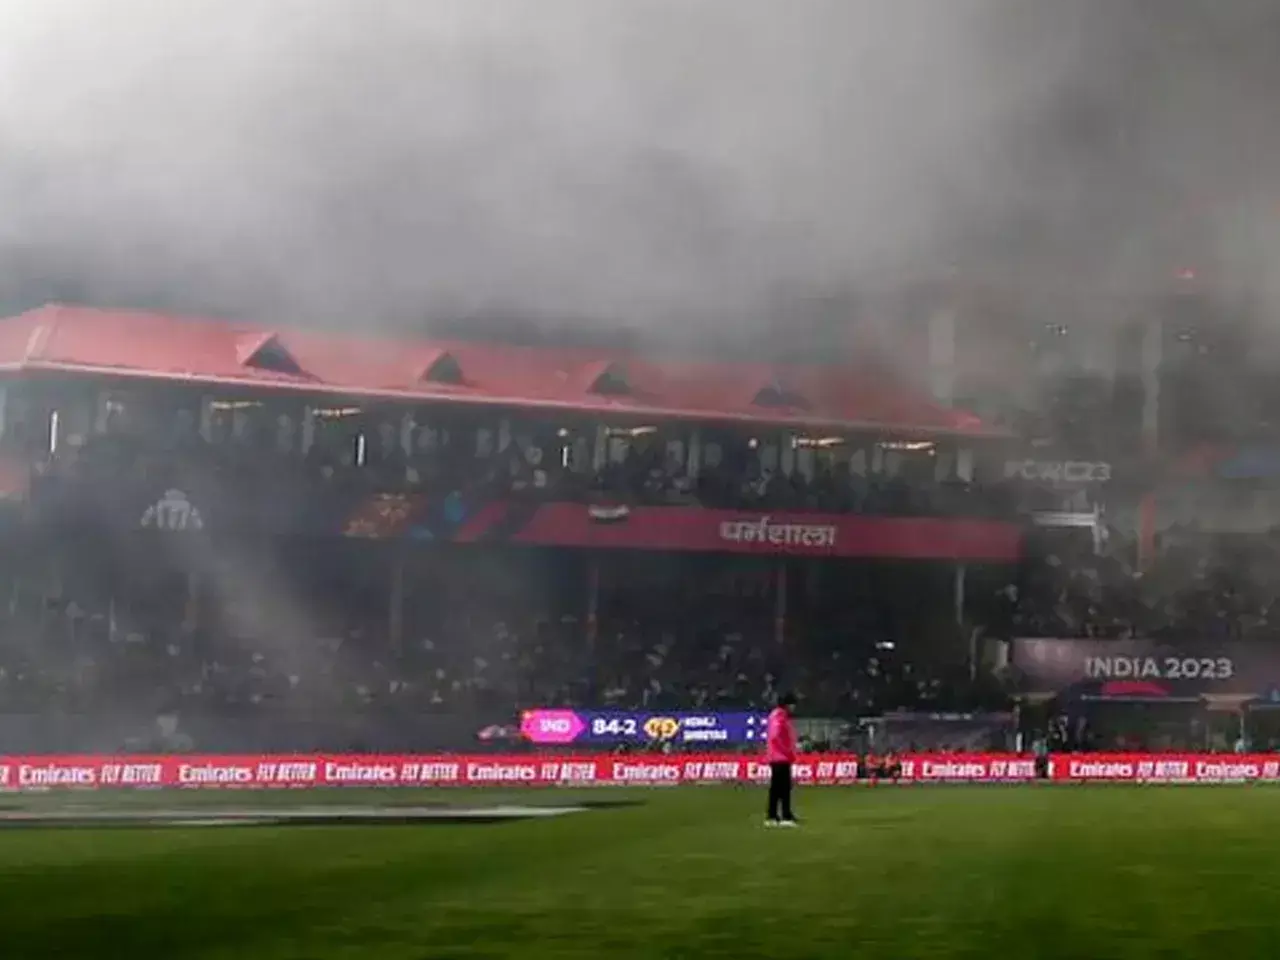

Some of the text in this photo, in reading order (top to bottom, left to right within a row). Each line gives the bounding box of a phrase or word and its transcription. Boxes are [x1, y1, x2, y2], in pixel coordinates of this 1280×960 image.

[720, 516, 837, 546] धर्मशाला
[1085, 657, 1233, 679] INDIA 2023
[593, 720, 637, 735] 84-2
[19, 764, 94, 783] Emirates
[180, 764, 251, 782] Emirates
[325, 763, 395, 781] Emirates
[467, 763, 536, 781] Emirates
[613, 762, 679, 780] Emirates
[747, 762, 813, 779] Emtes
[923, 762, 986, 778] Emirates
[1070, 761, 1132, 777] Emirates
[1196, 762, 1258, 777] Emirates
